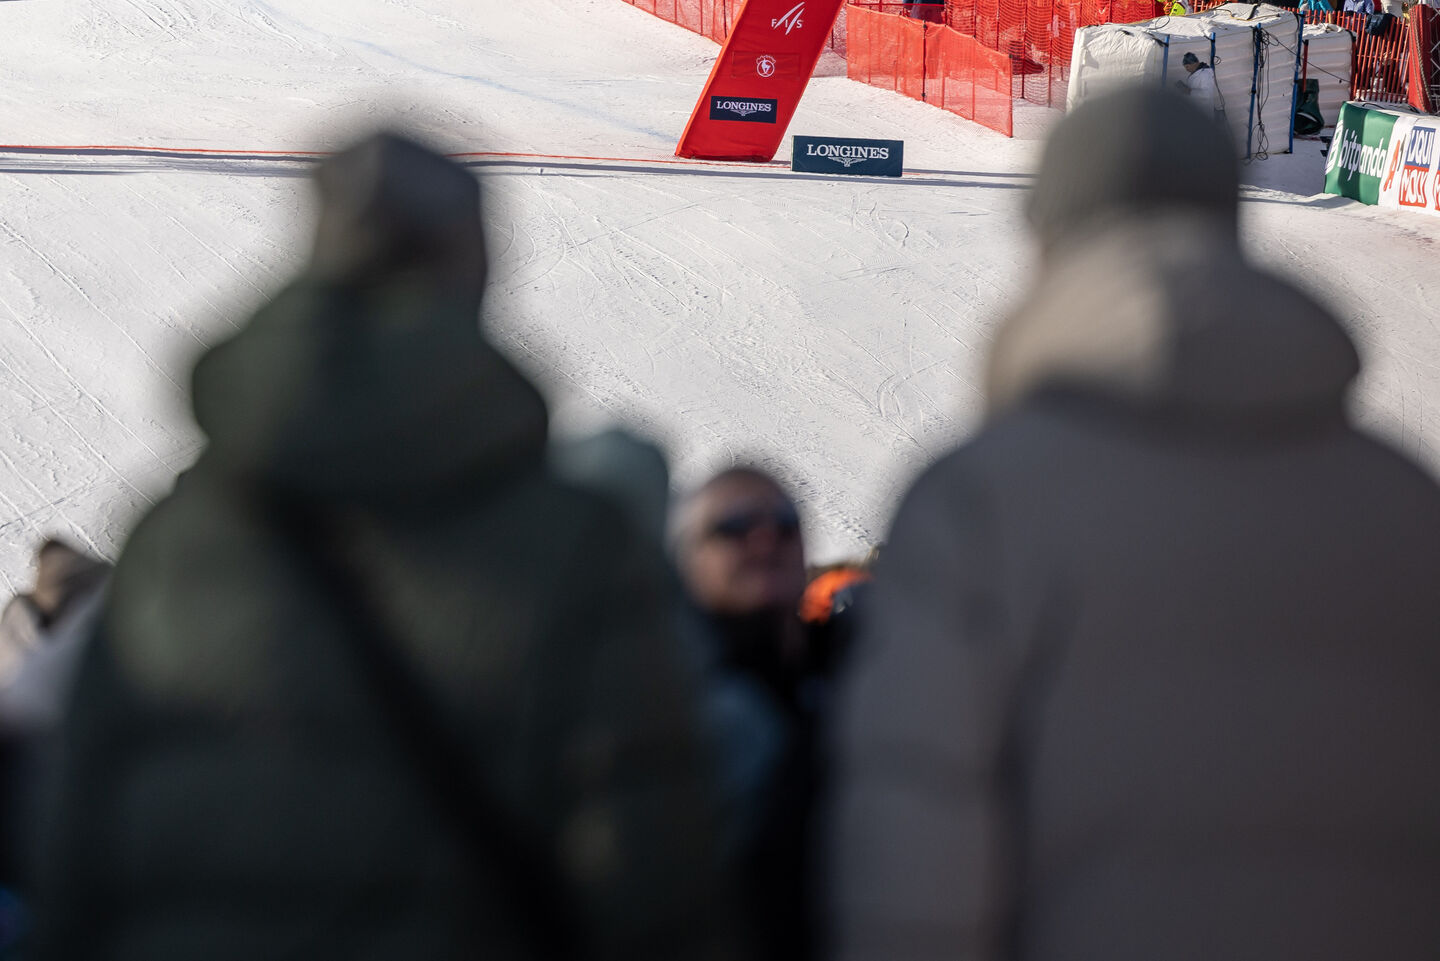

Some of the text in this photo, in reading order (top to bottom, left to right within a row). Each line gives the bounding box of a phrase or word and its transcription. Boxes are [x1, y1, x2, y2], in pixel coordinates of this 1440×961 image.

[716, 101, 772, 113] LONGINES
[806, 144, 890, 160] LONGINES
[1337, 128, 1388, 182] bitpanda
